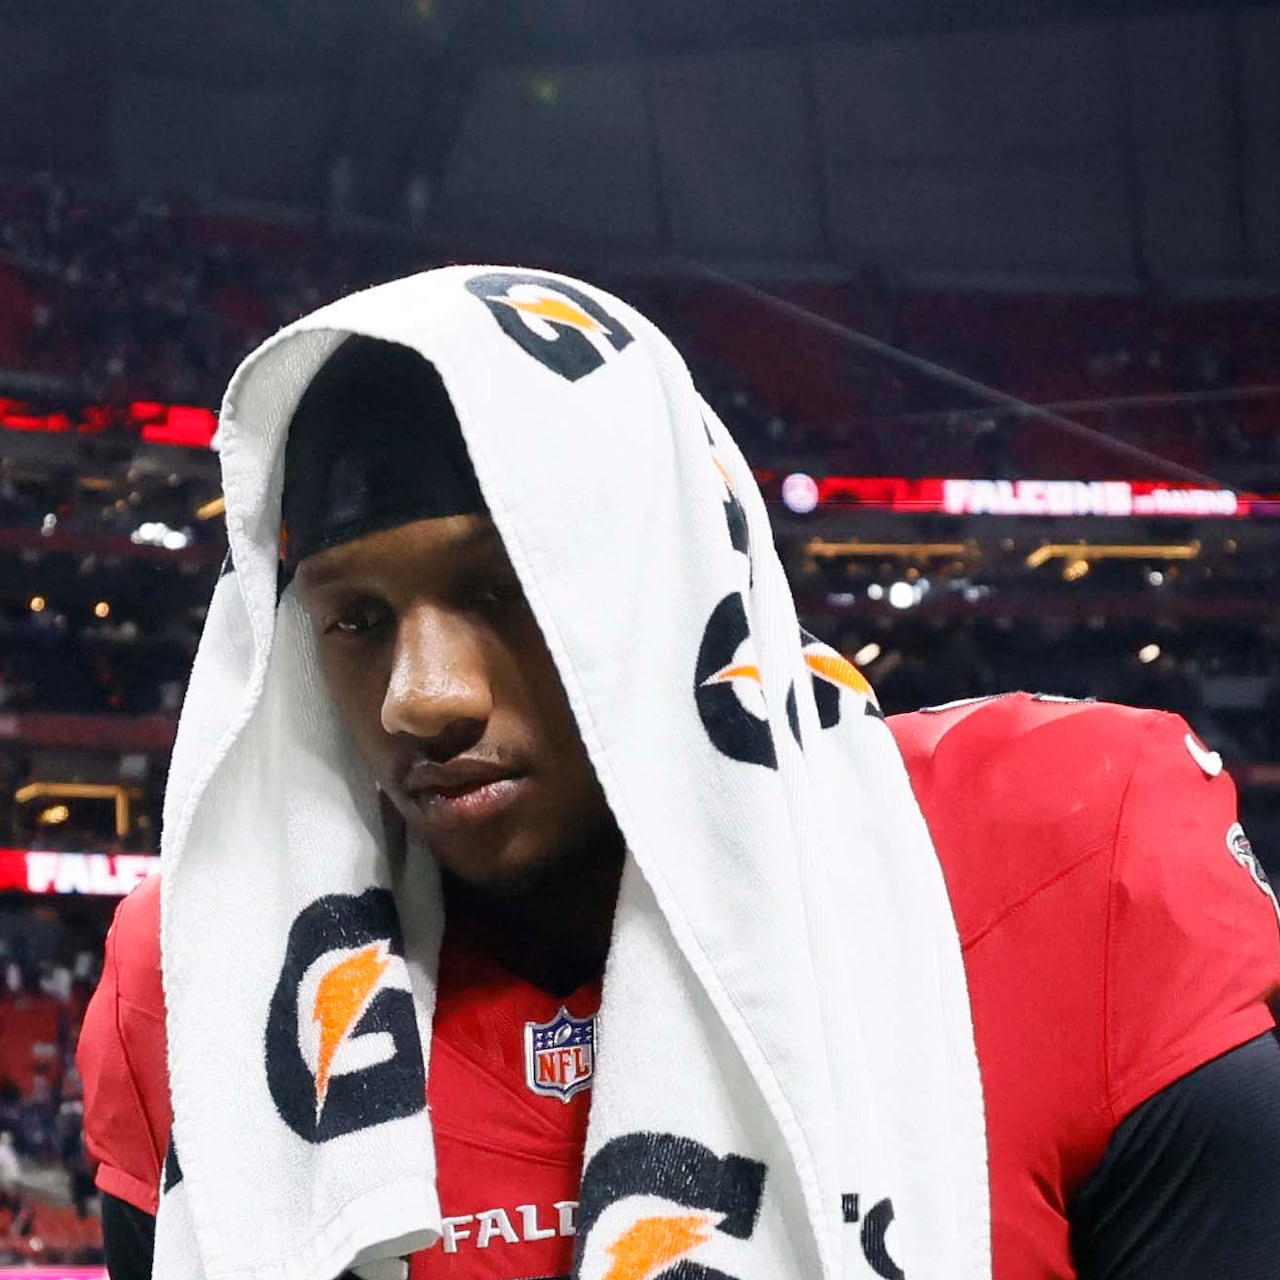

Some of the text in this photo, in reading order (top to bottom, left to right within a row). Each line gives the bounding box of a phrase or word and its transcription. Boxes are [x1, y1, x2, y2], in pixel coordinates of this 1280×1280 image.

[465, 272, 636, 383] G
[943, 478, 1132, 516] FALCONS
[265, 887, 428, 1145] G
[537, 1047, 590, 1085] NFL
